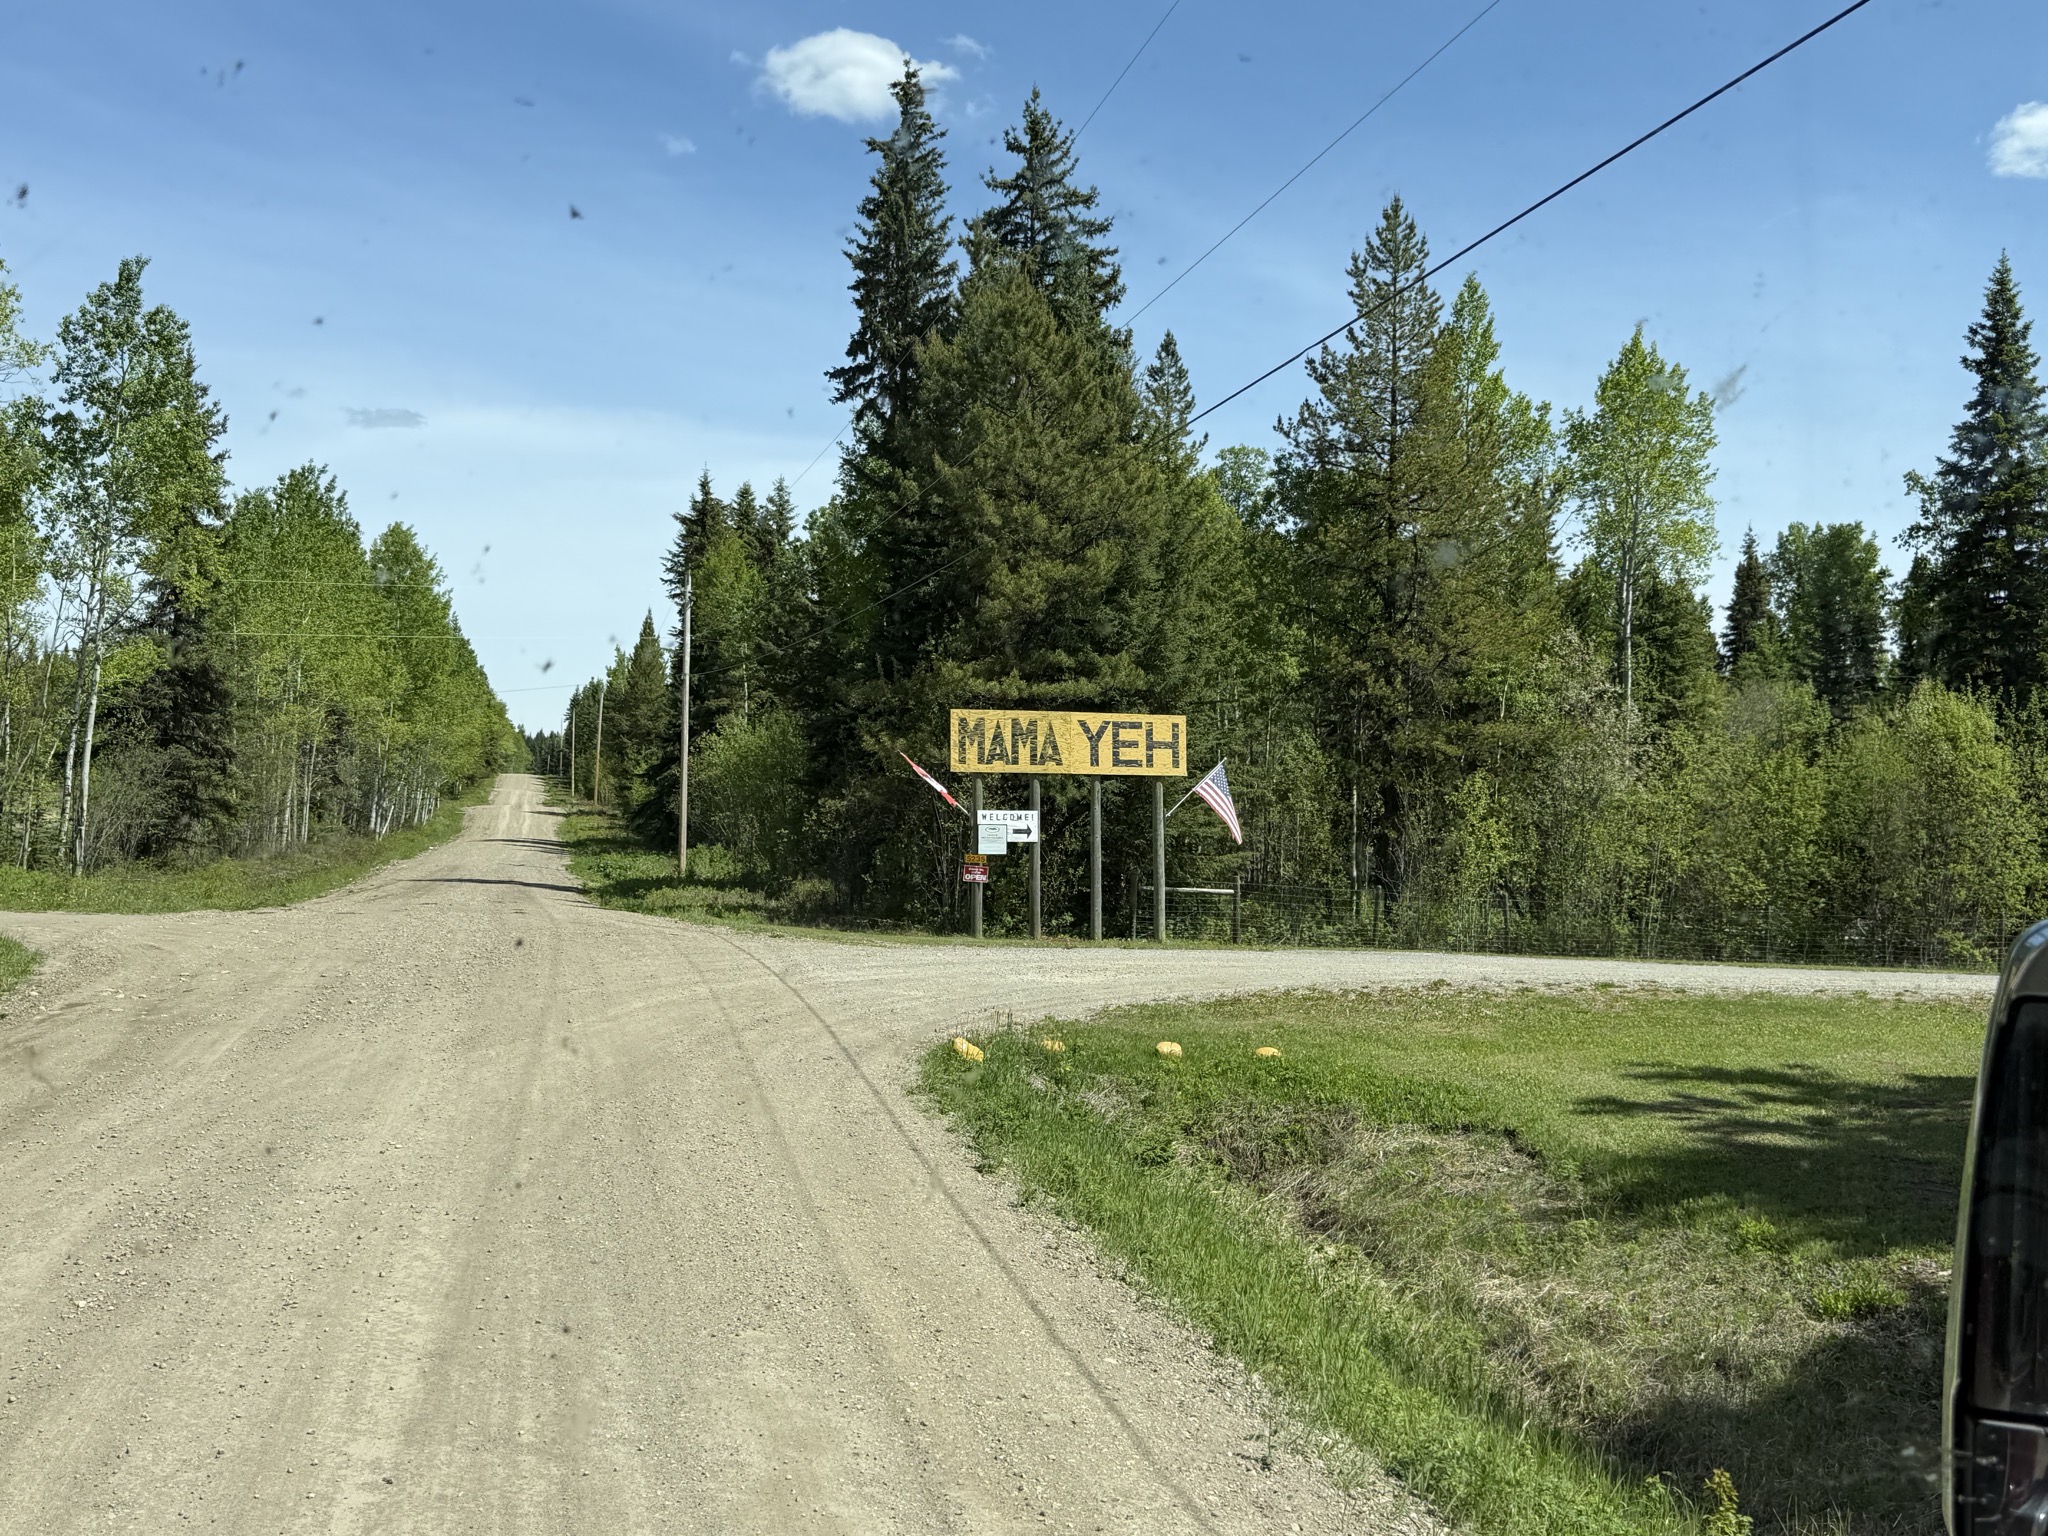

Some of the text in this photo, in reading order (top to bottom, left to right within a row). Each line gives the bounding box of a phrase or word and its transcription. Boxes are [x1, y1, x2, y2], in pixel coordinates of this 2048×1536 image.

[958, 717, 1180, 769] MAMA YEH
[981, 813, 1034, 821] WELCOME!
